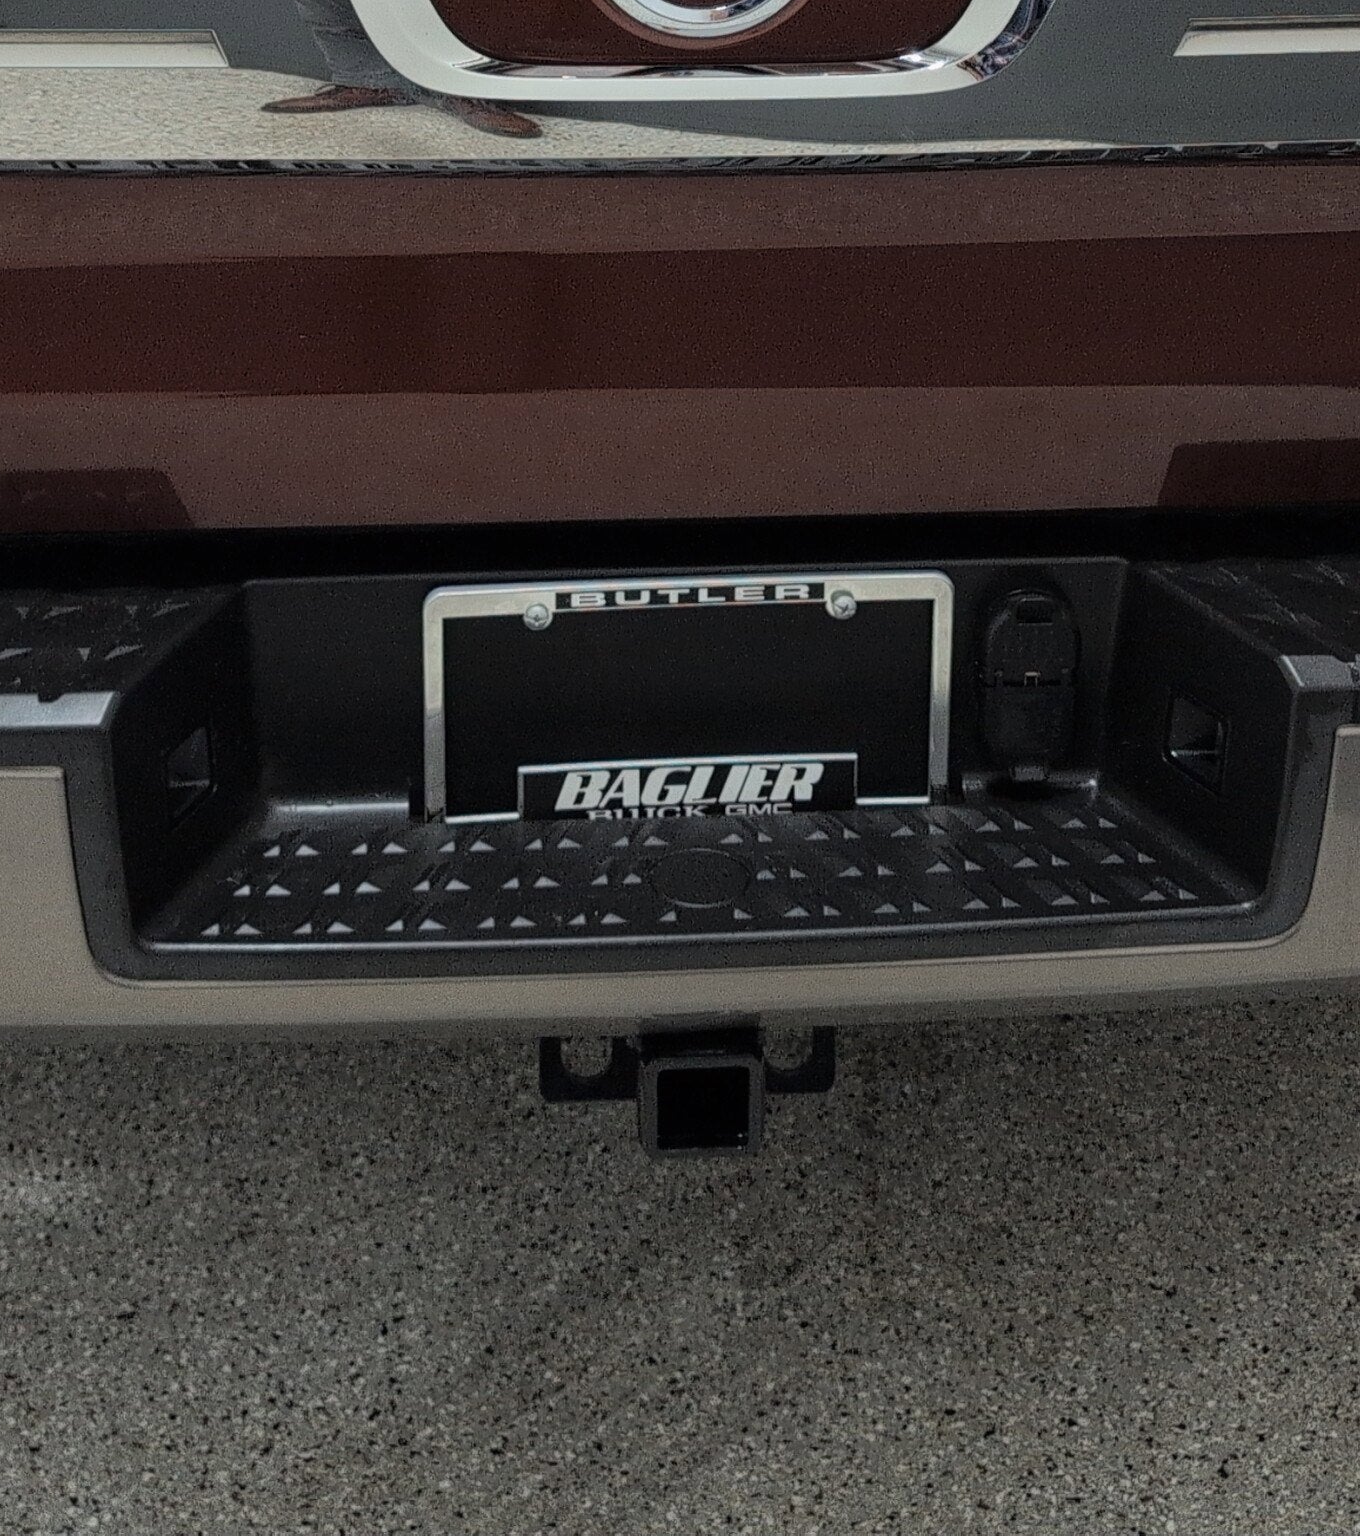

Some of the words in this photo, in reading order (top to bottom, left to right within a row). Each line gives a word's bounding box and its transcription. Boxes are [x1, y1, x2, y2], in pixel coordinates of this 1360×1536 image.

[570, 583, 810, 608] BUTLER
[554, 762, 825, 811] BAGLIER
[725, 802, 794, 815] GMC
